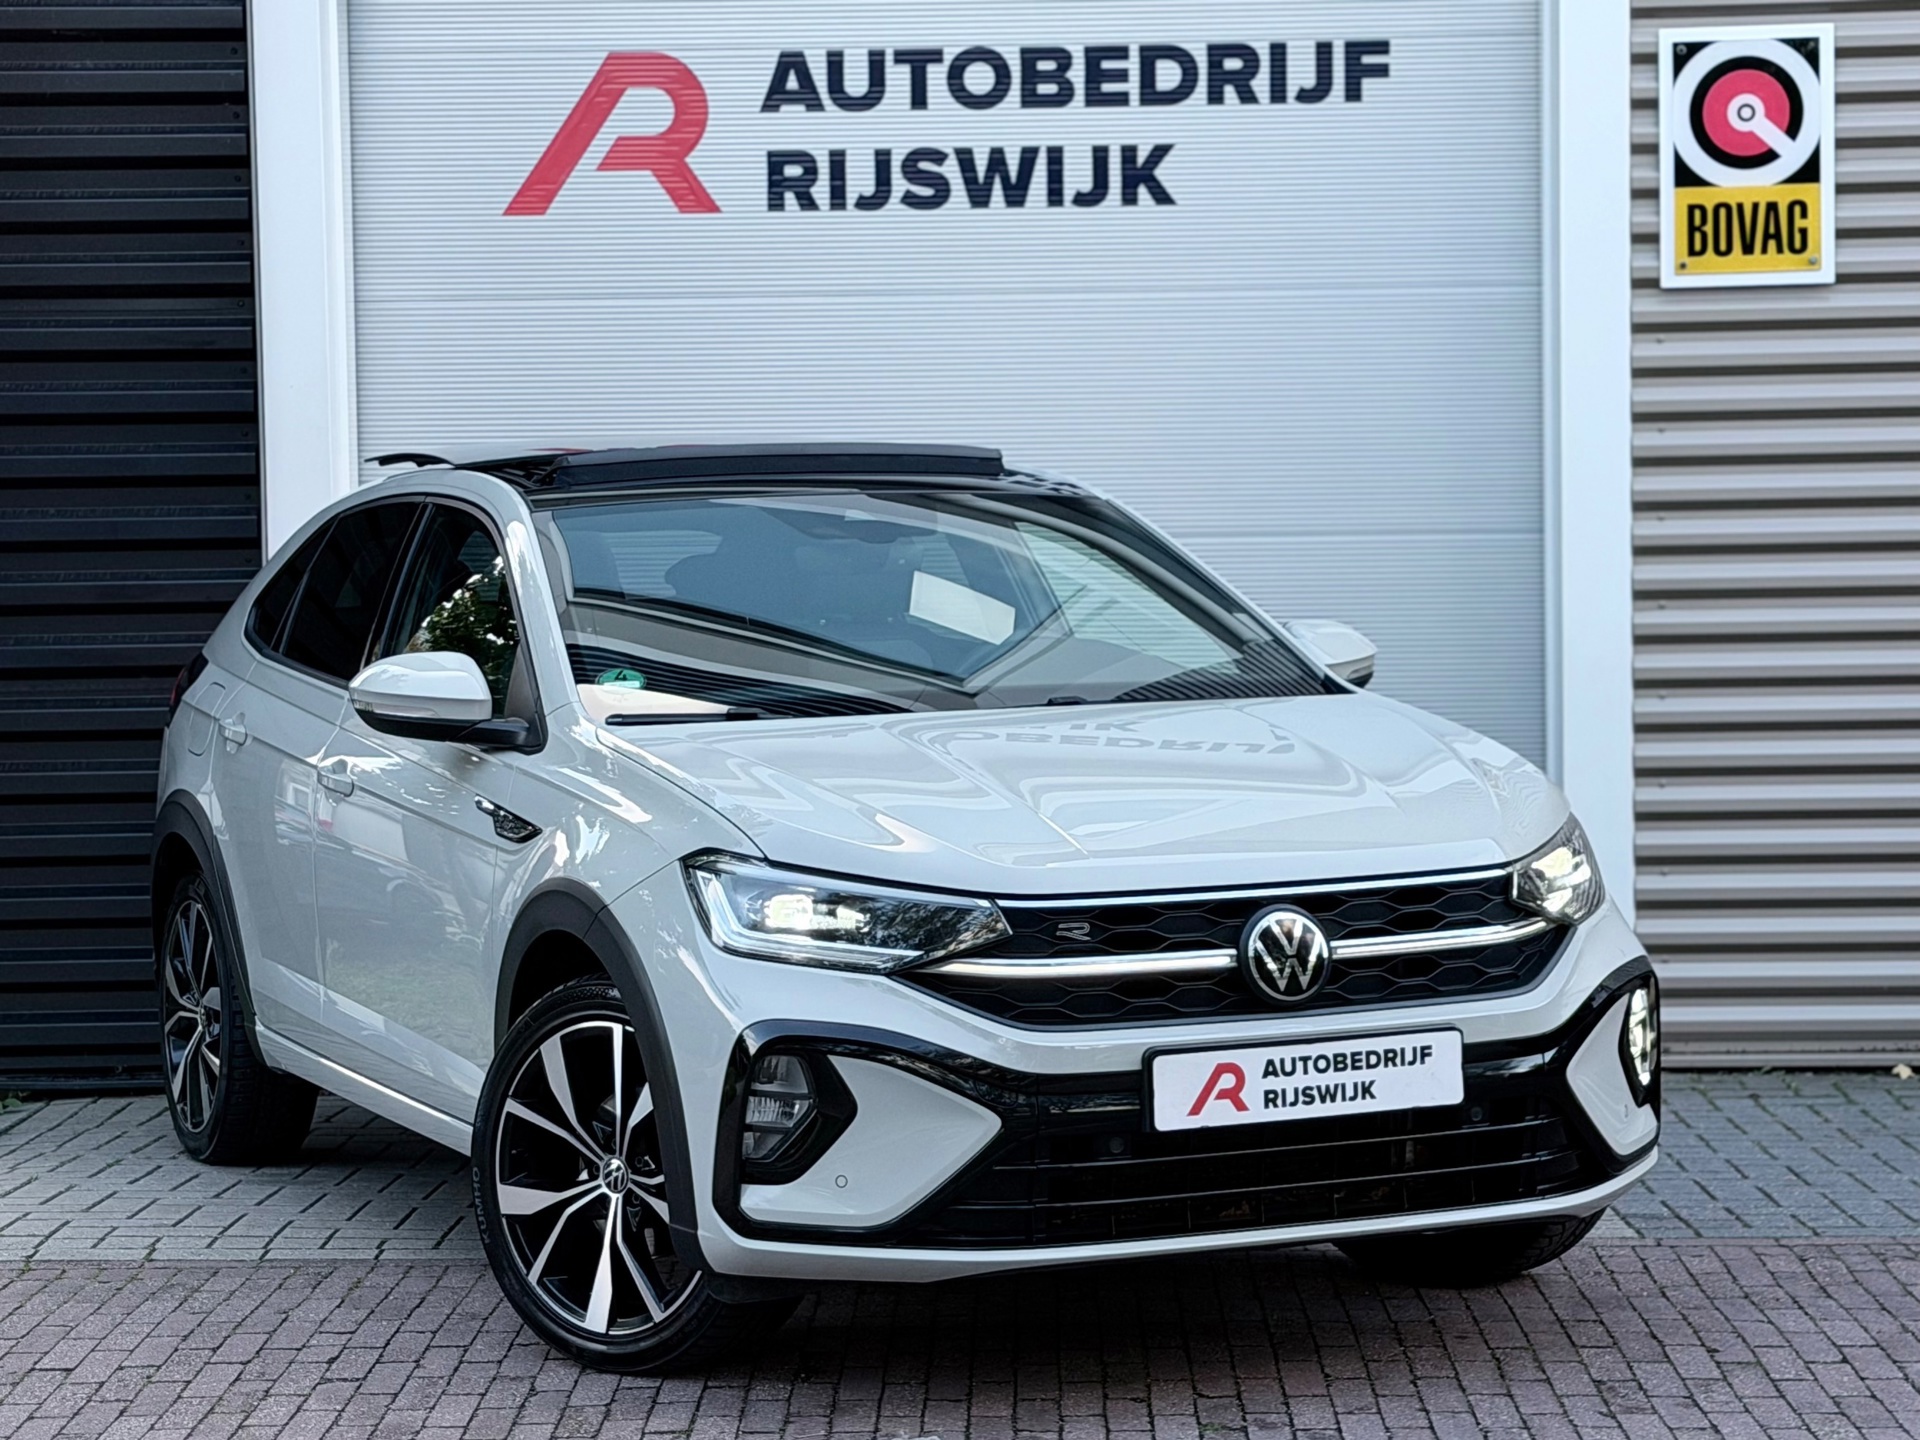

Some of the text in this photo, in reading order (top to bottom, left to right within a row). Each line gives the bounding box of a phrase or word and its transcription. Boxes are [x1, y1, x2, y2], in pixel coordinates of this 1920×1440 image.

[760, 40, 1391, 112] AUTOBEDRIJF
[766, 144, 1177, 212] RIJSWIJK
[1687, 199, 1809, 257] BOVAG
[1262, 1045, 1433, 1079] AUTOBEDRIJF
[1263, 1080, 1377, 1109] RIJSWIJK
[472, 1166, 491, 1244] KUMHO
